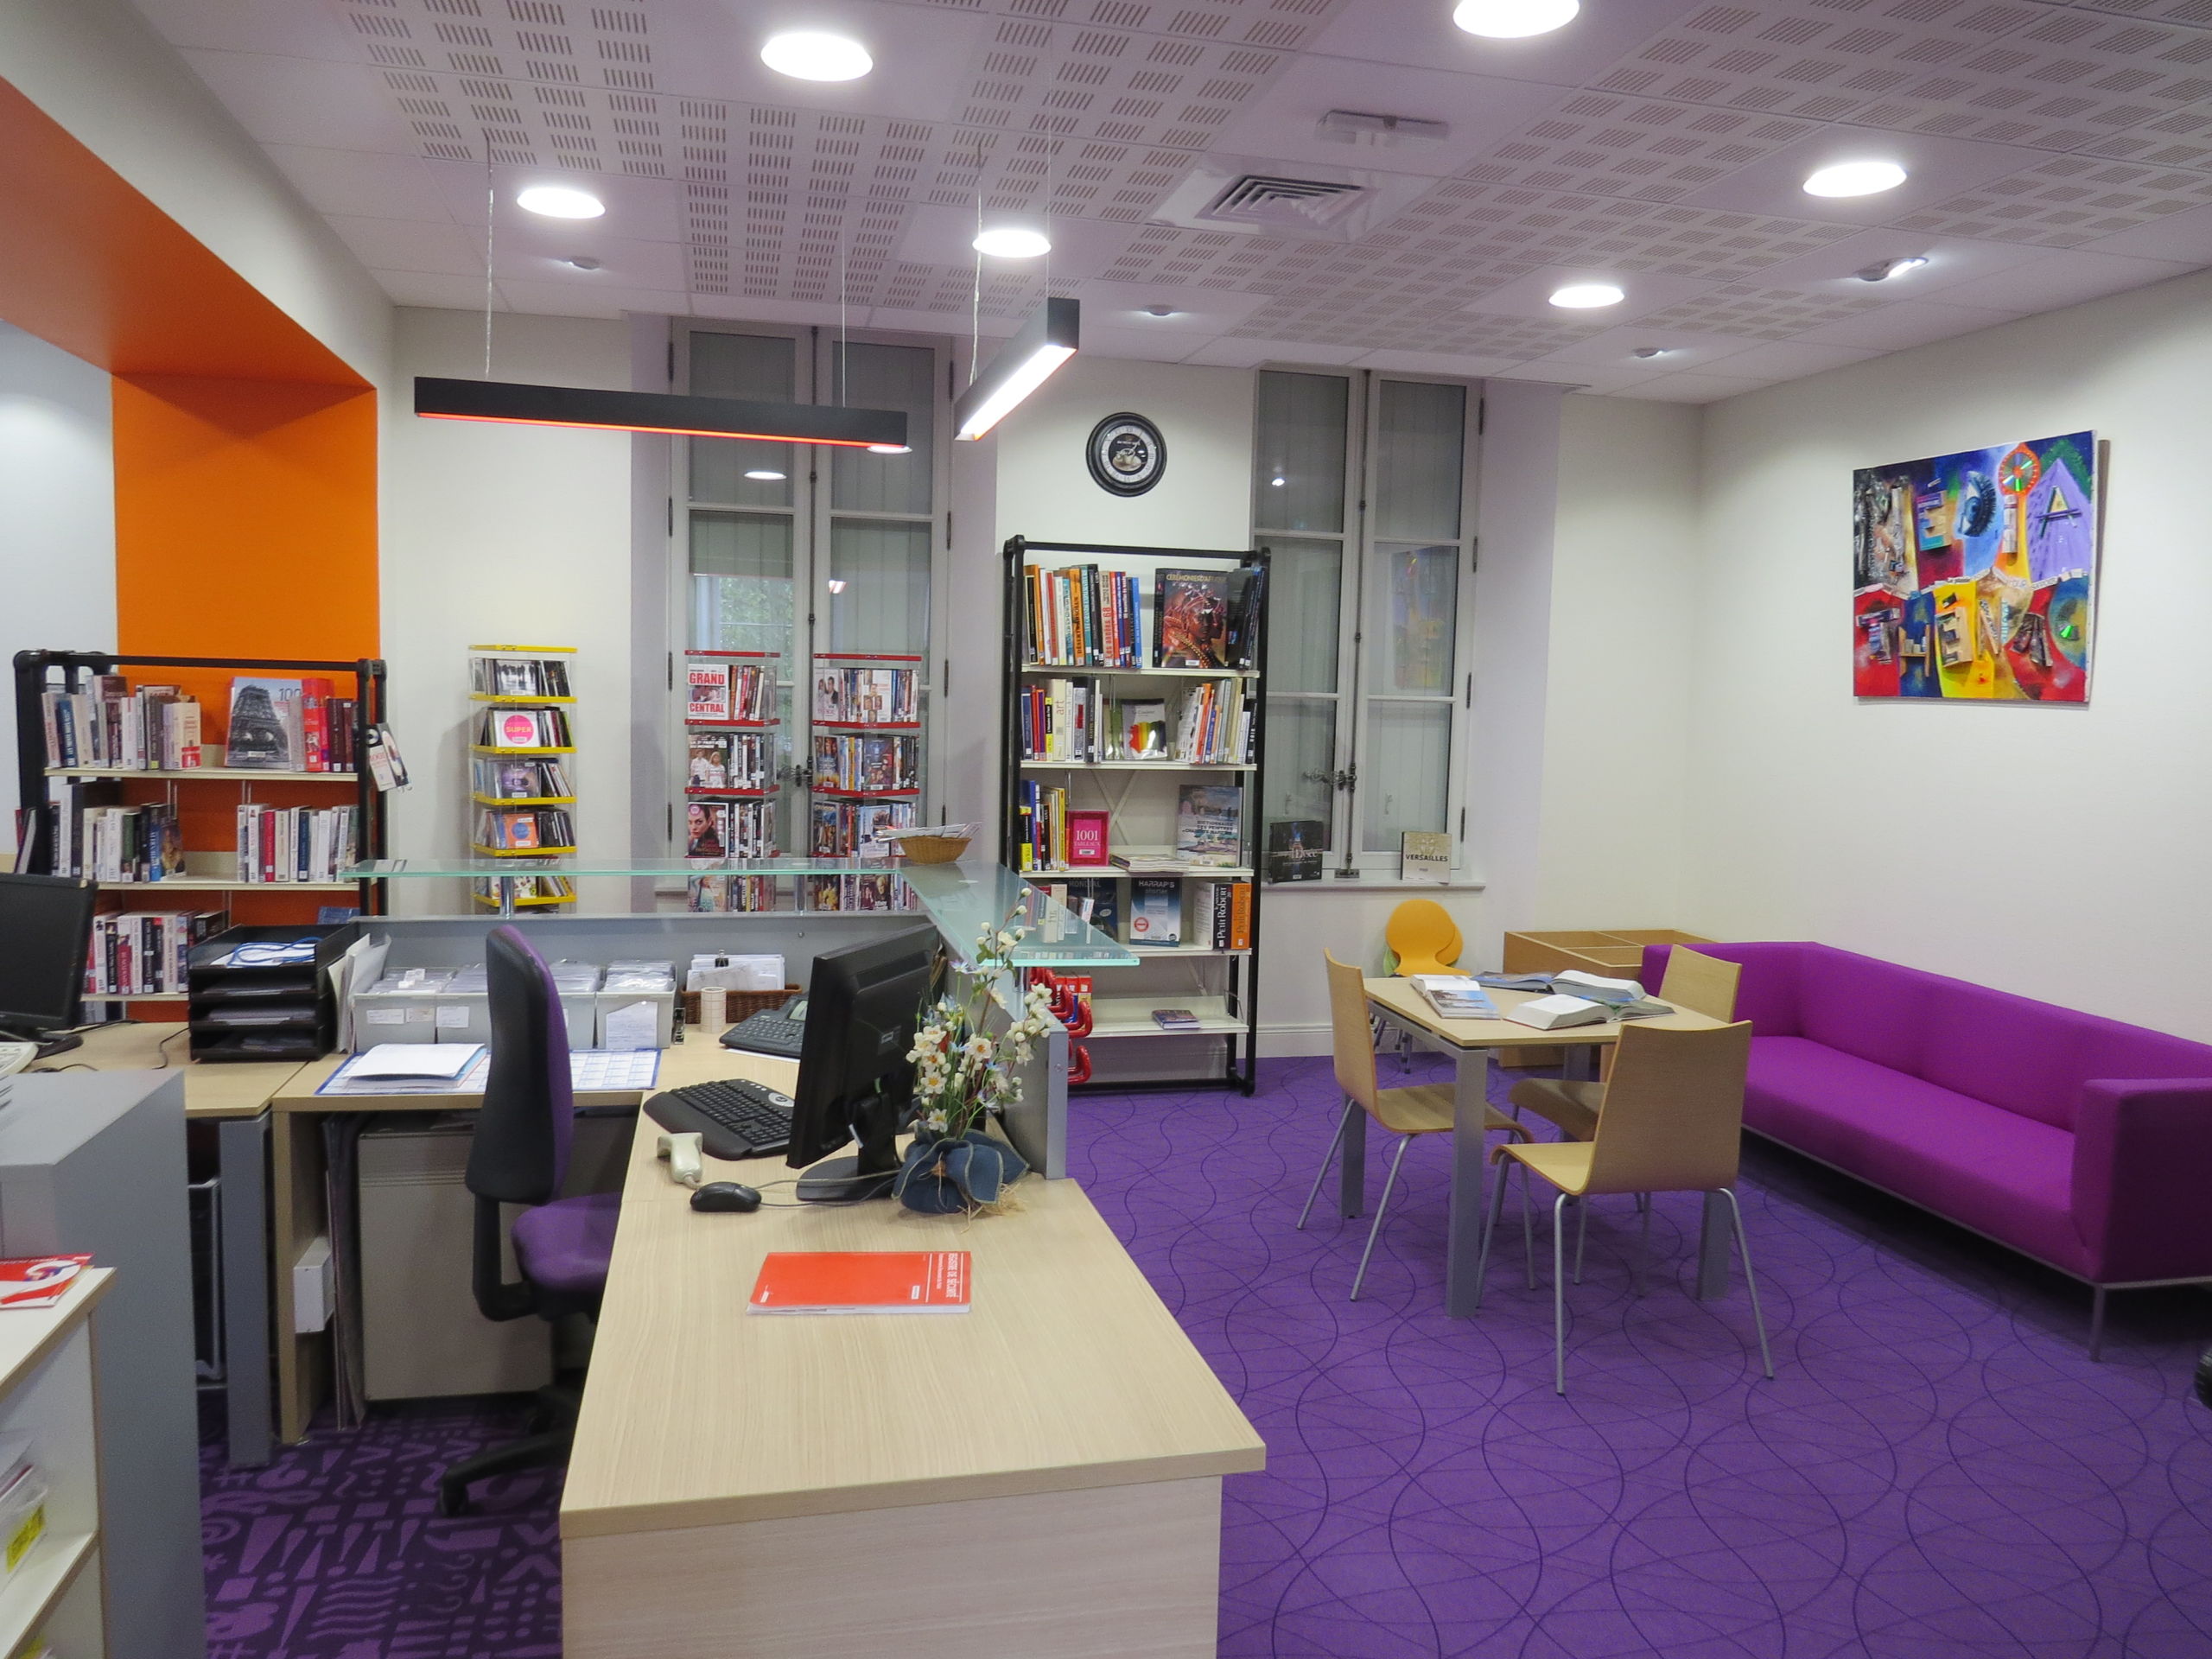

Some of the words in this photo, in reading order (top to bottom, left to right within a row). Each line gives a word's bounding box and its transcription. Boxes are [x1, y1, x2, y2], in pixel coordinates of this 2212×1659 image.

[689, 672, 725, 685] GRAND
[689, 702, 725, 713] CENTRAL
[1055, 700, 1065, 715] art
[1076, 830, 1098, 841] 1001
[1405, 853, 1448, 862] VERSAILLES
[1138, 880, 1175, 888] HARRAP'S
